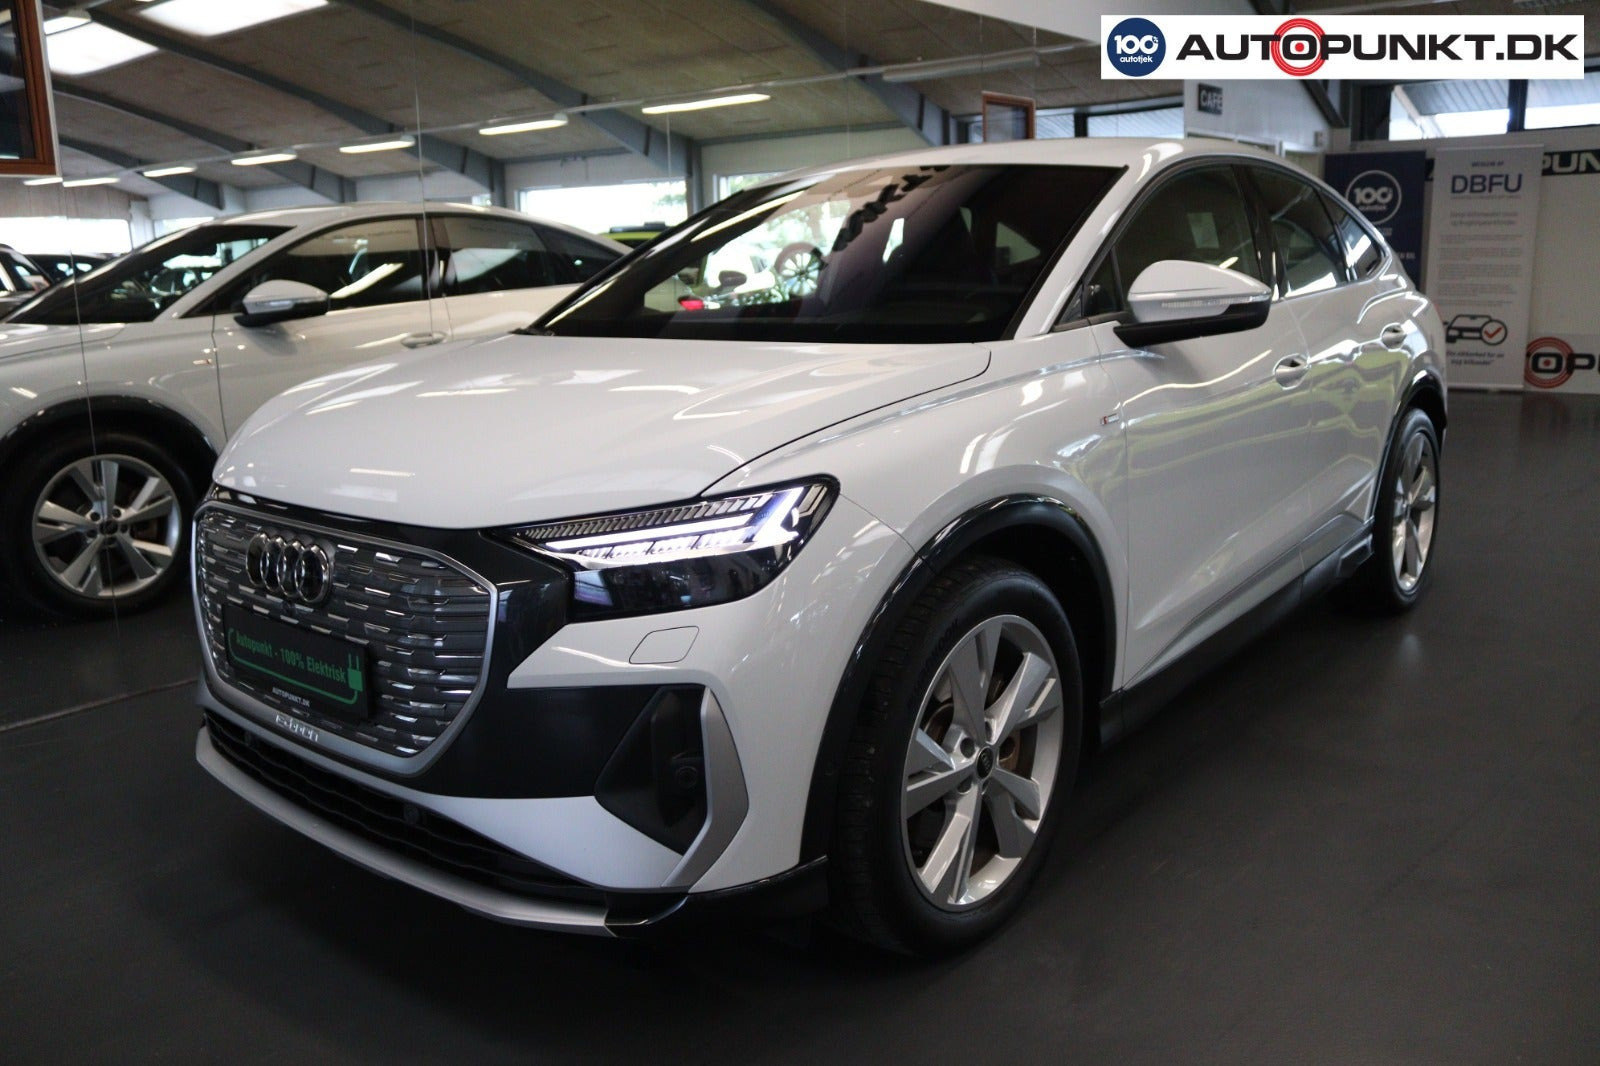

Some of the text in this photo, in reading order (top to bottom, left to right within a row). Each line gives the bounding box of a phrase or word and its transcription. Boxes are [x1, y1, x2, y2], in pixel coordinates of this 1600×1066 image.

[1450, 173, 1524, 194] DBFU
[1526, 352, 1600, 375] OP
[280, 648, 305, 670] 100%
[306, 656, 347, 683] Elektrisk
